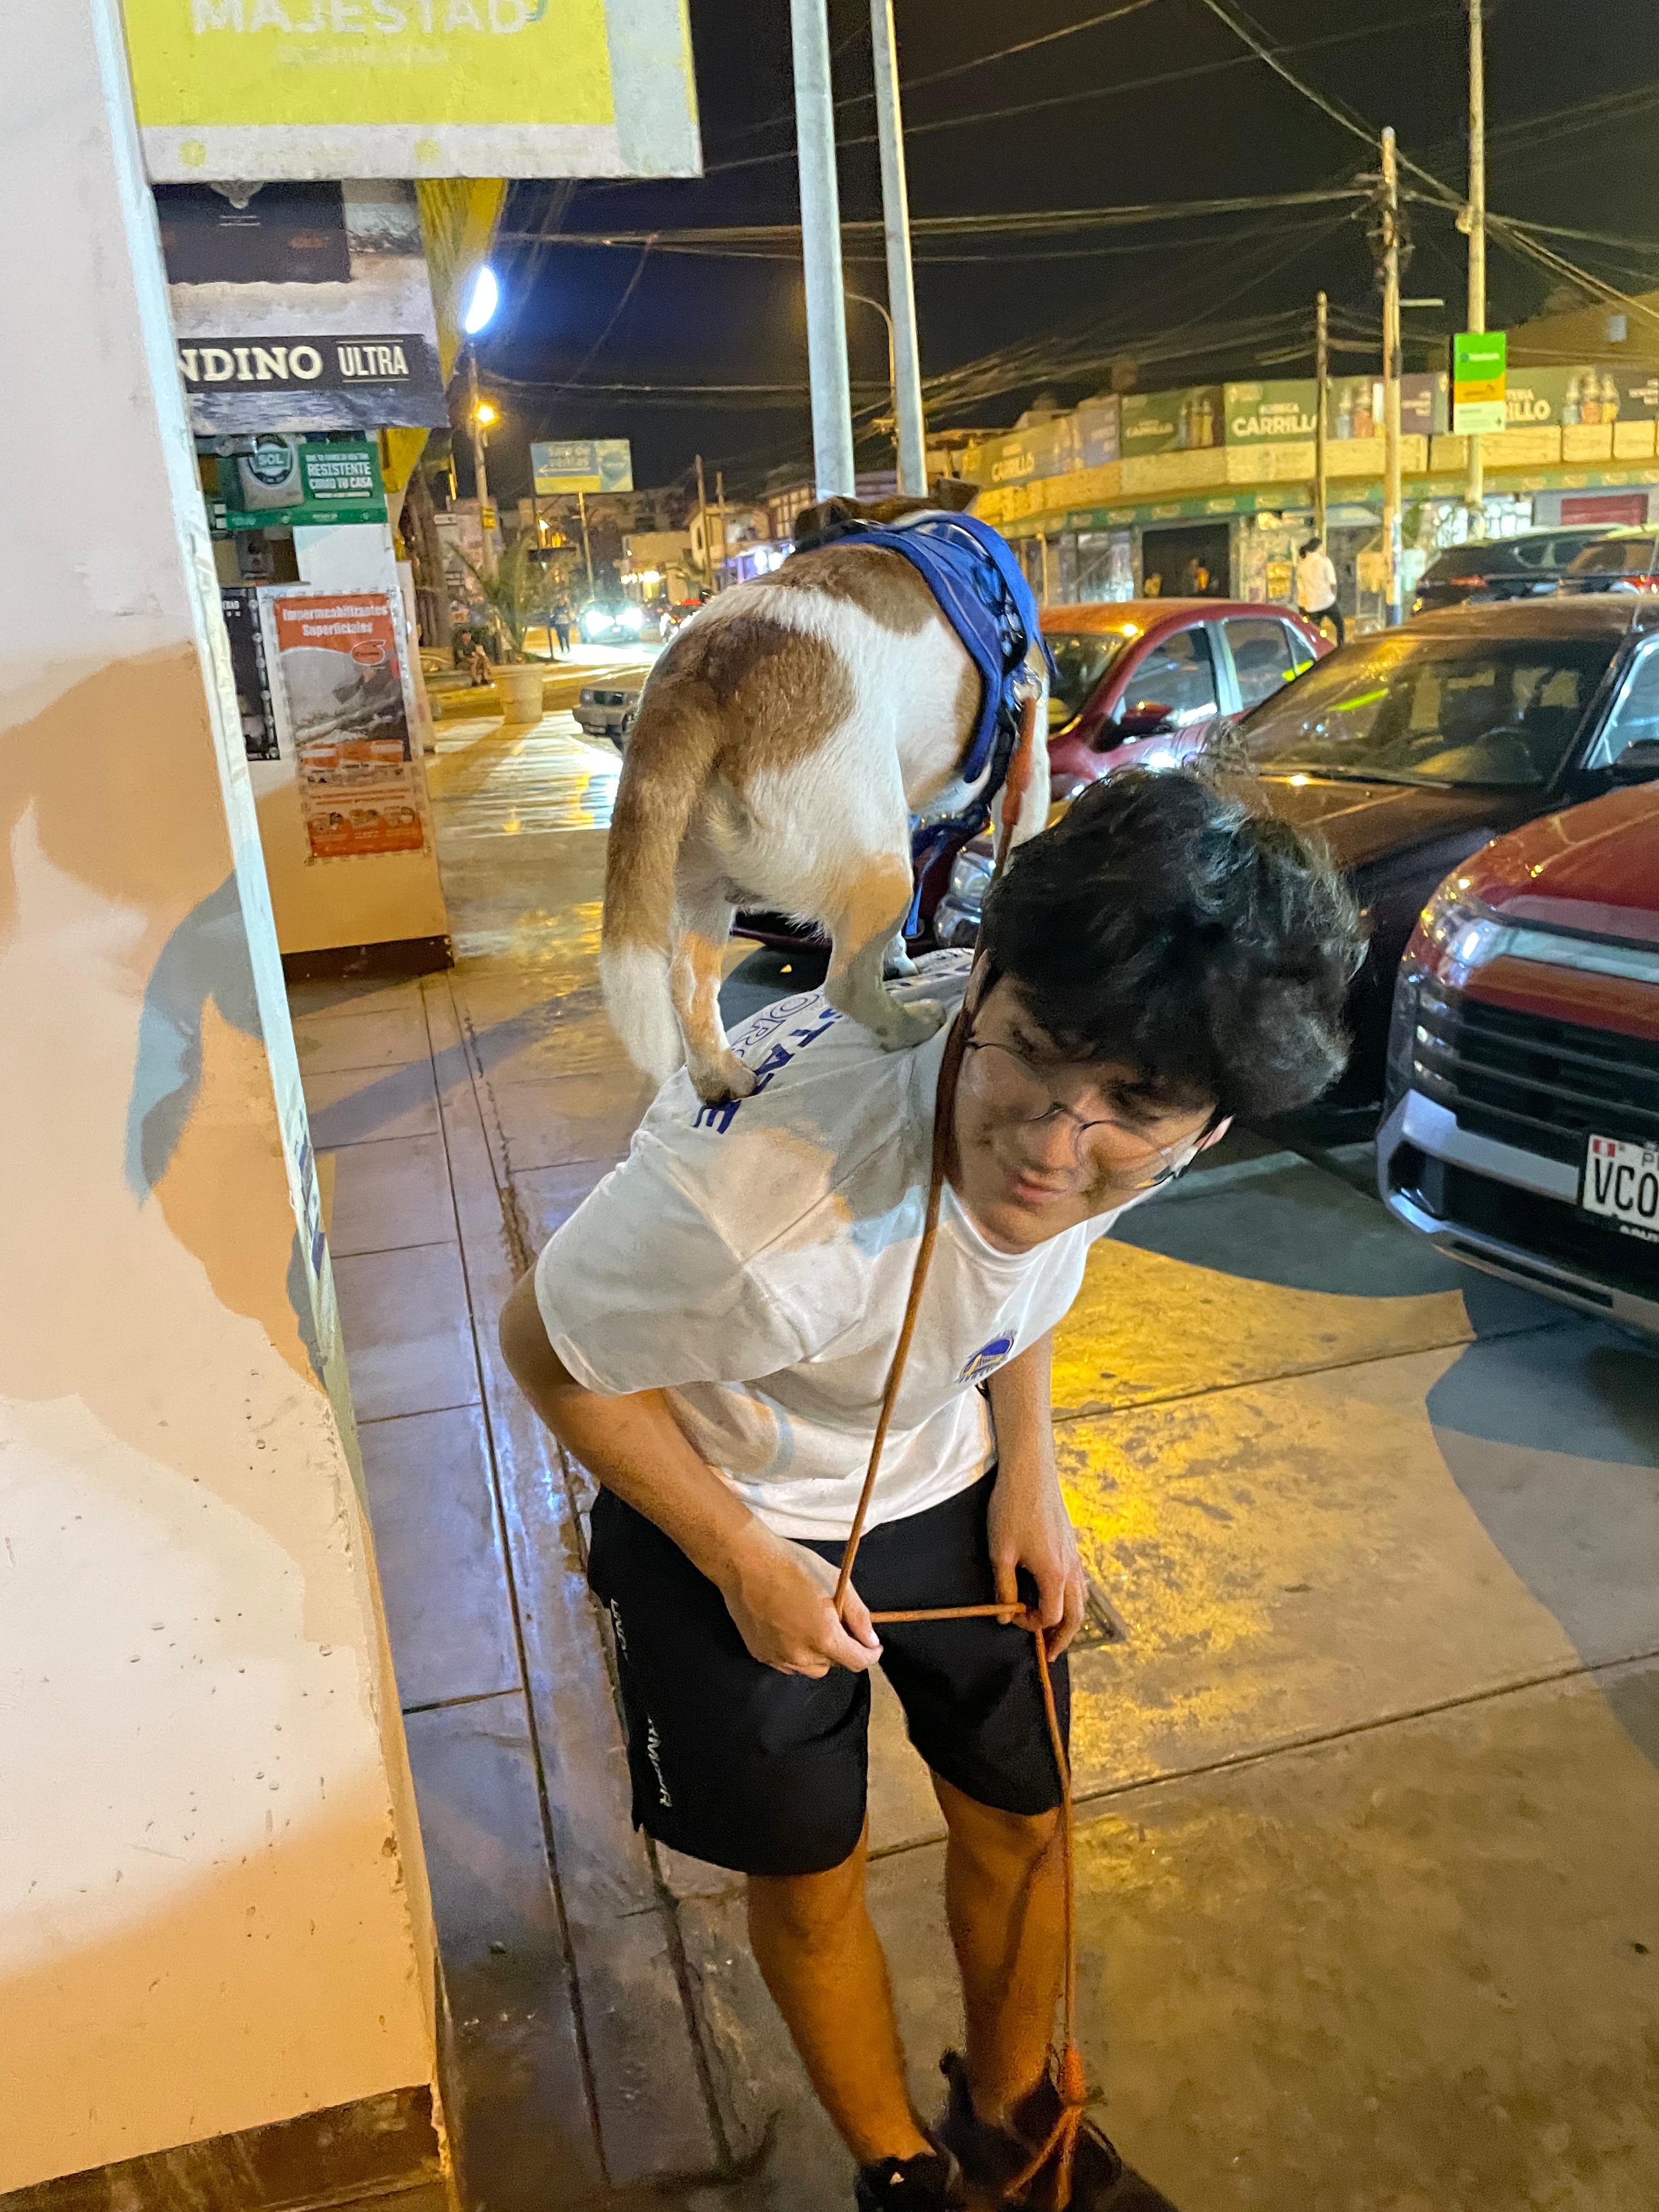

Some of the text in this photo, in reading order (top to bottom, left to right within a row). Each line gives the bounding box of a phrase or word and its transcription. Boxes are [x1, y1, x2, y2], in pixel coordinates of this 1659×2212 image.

[337, 346, 409, 376] ULTRA
[257, 454, 284, 466] SOL
[307, 461, 372, 477] RESISTENTE
